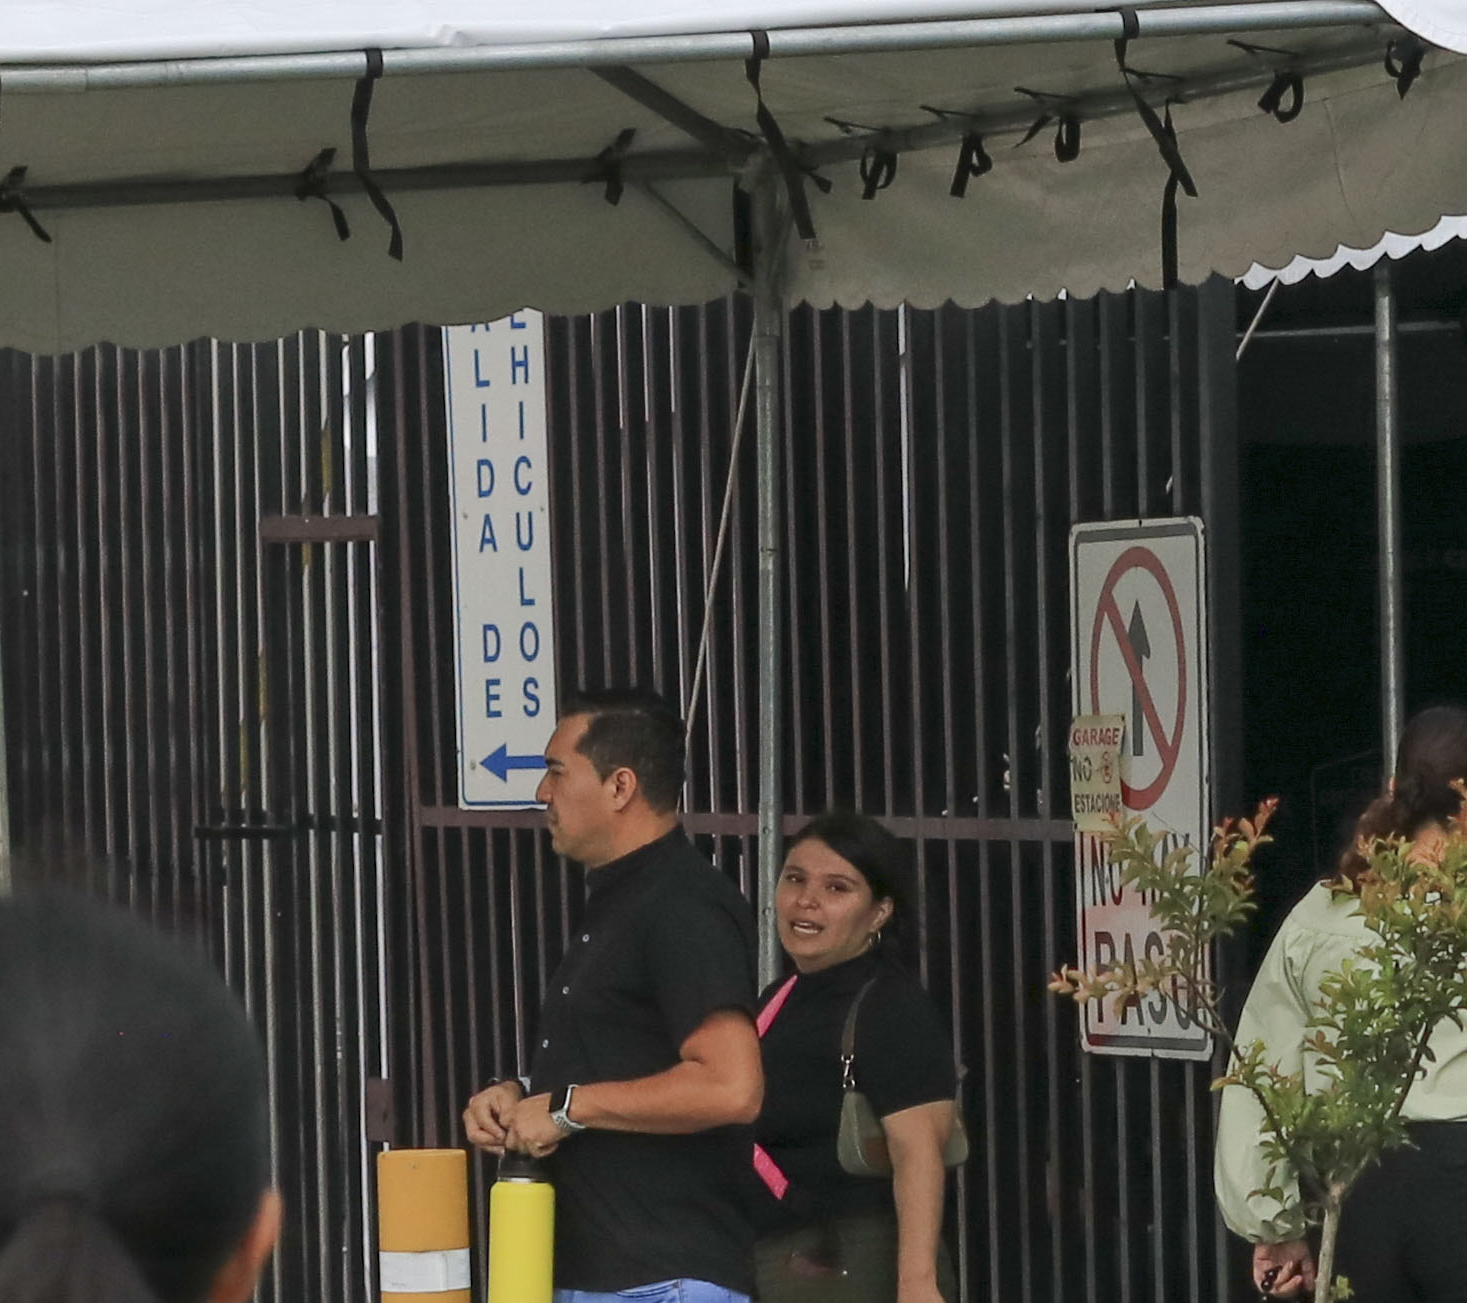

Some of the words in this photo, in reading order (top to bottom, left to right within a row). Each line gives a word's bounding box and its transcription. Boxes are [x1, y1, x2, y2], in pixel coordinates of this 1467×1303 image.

[1073, 727, 1121, 747] GARAGE
[1072, 754, 1093, 783] NO
[1074, 793, 1121, 814] ESTACIONE
